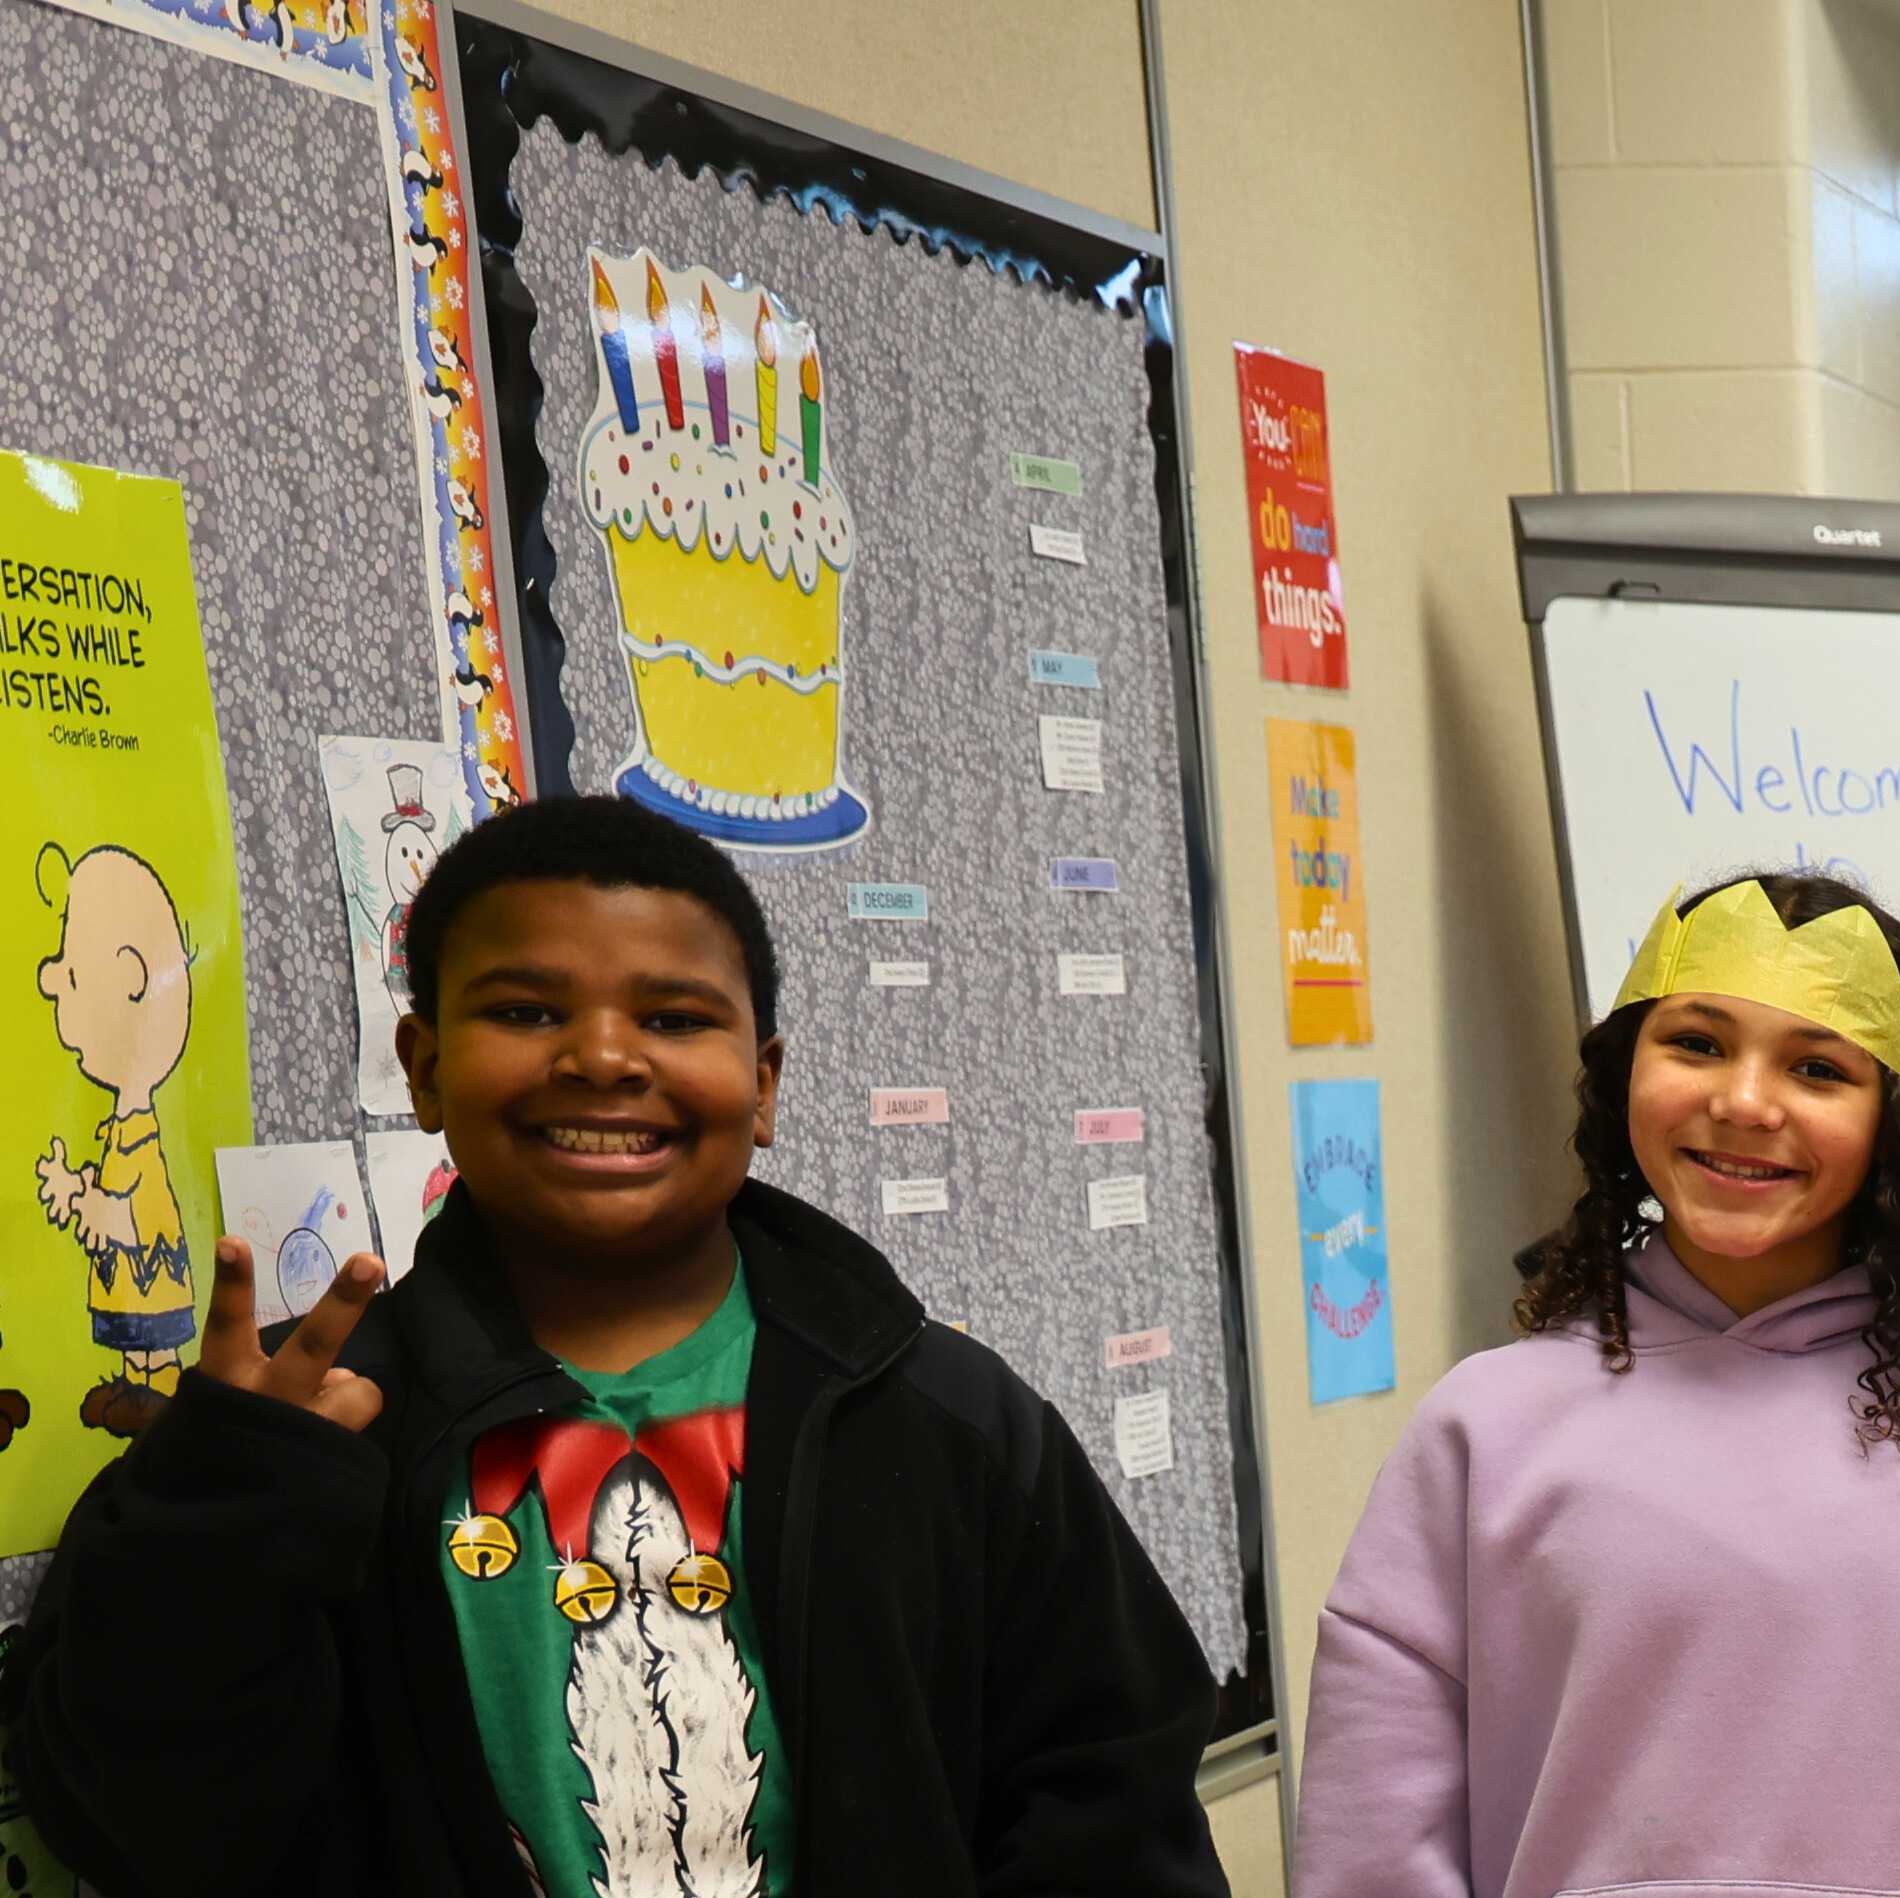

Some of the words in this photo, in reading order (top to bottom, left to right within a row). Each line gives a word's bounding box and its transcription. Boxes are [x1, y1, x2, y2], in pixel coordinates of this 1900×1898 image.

[1252, 400, 1288, 450] You
[1026, 463, 1052, 483] APRIL
[1259, 487, 1291, 551] do
[1813, 523, 1882, 548] Quartet
[1, 559, 152, 624] ERSATION,
[1263, 567, 1342, 648] things.
[0, 612, 60, 659] LKS
[66, 624, 145, 668] WHILE
[1042, 659, 1064, 674] MAY
[0, 669, 110, 716] ISTENS.
[99, 729, 139, 750] Brown
[1290, 775, 1339, 820] Make
[1064, 867, 1089, 881] JUNE
[1290, 836, 1350, 902] today
[863, 891, 914, 909] DECEMBER
[885, 1099, 929, 1115] JANUARY
[1089, 1119, 1111, 1134] JULY
[1119, 1338, 1152, 1357] AUGUST
